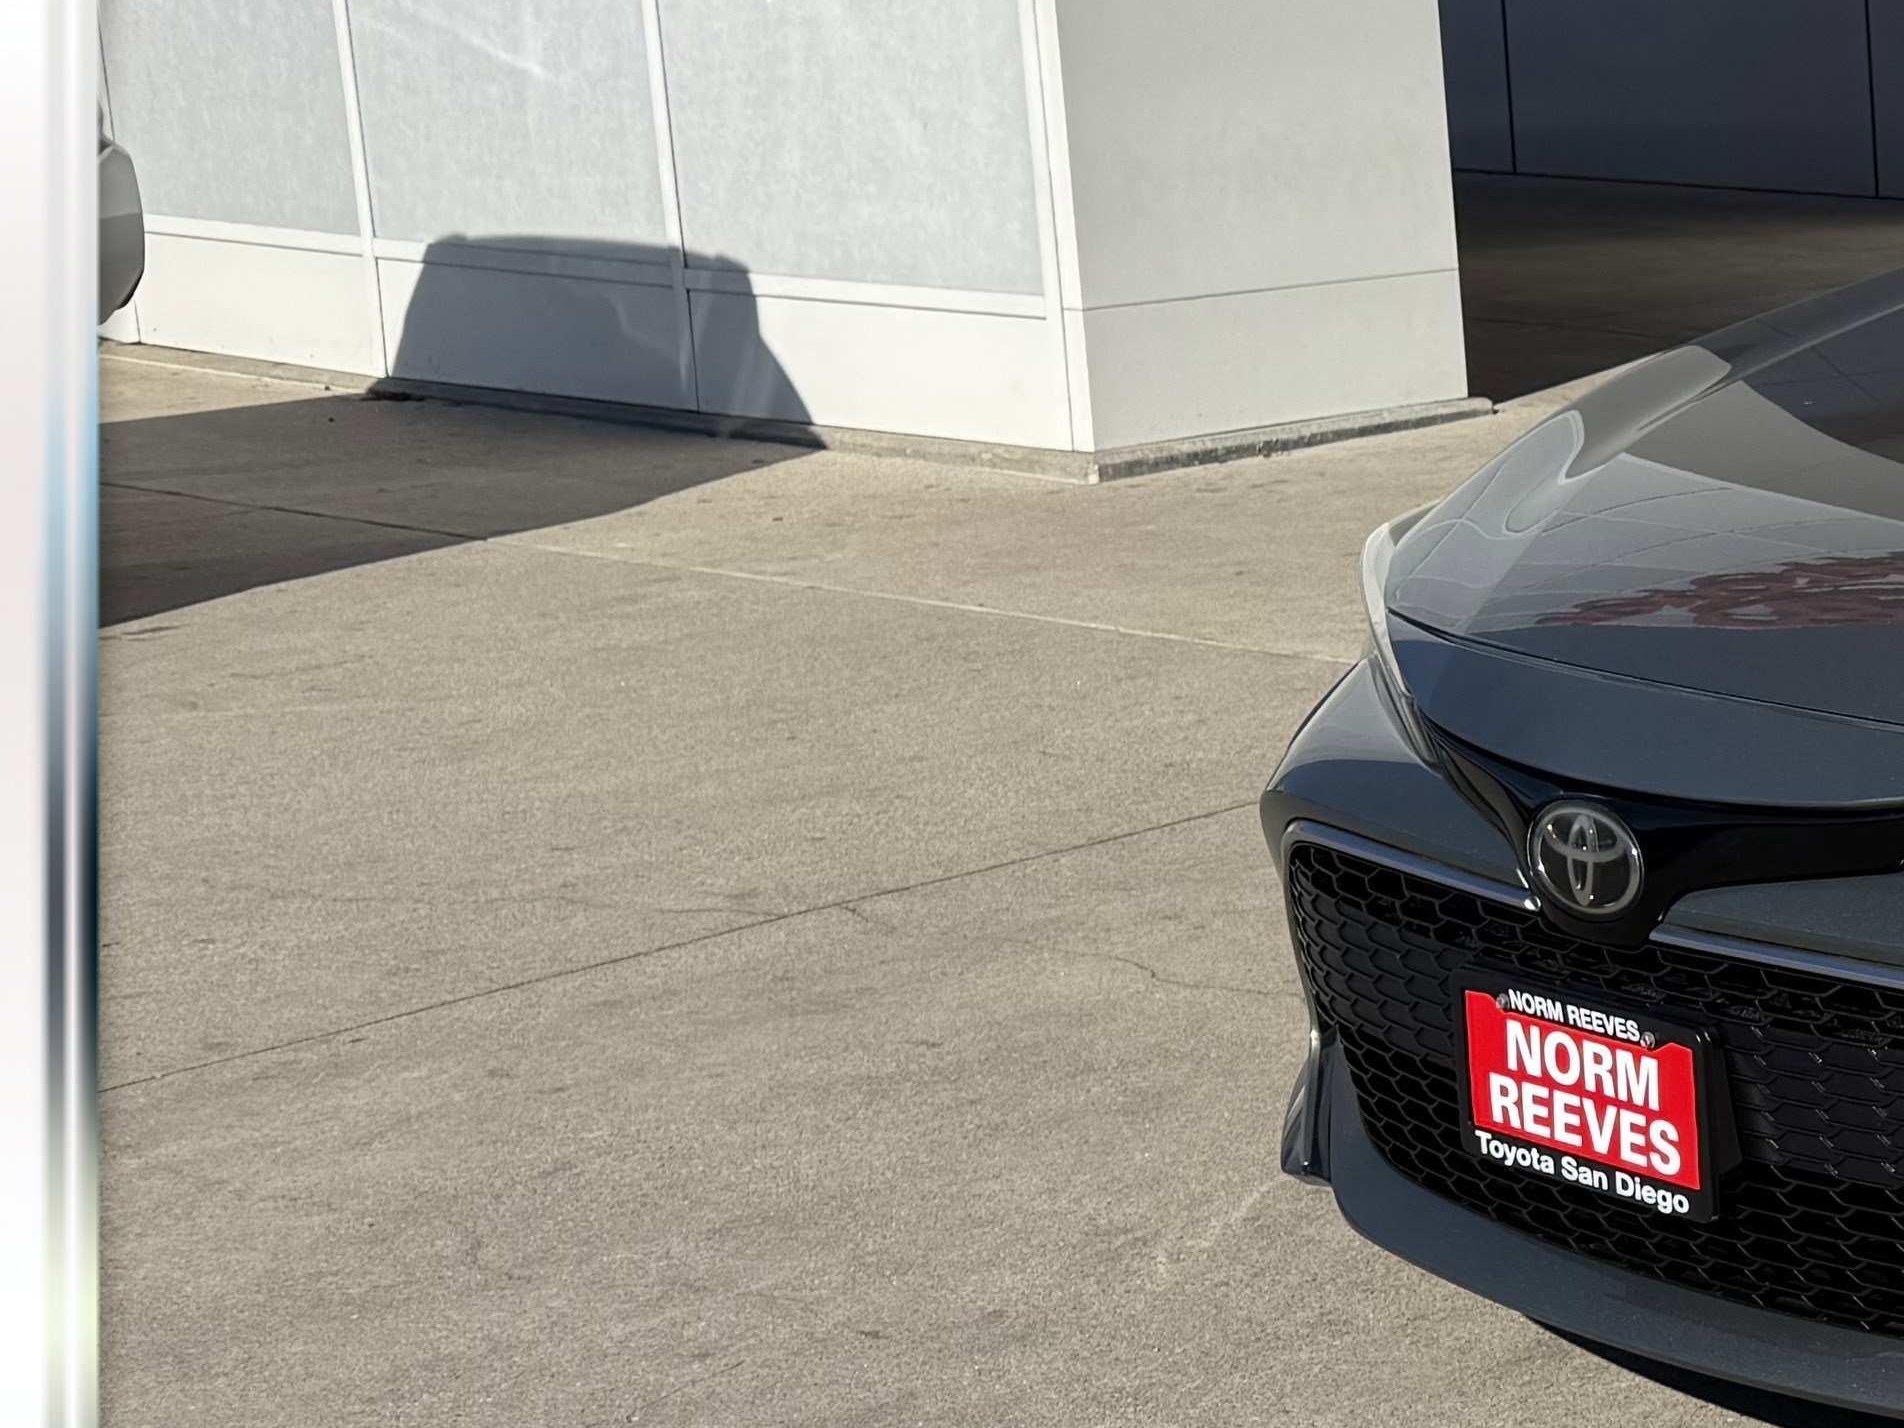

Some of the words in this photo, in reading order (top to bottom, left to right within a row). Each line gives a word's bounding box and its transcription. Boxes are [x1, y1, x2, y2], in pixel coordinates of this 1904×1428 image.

[1508, 988, 1564, 1023] NORM
[1567, 1003, 1641, 1043] REEVES
[1505, 1018, 1660, 1113] NORM
[1488, 1071, 1682, 1177] REEVES
[1474, 1128, 1556, 1176] Toyota
[1560, 1158, 1610, 1192] San
[1615, 1171, 1690, 1216] Diego
